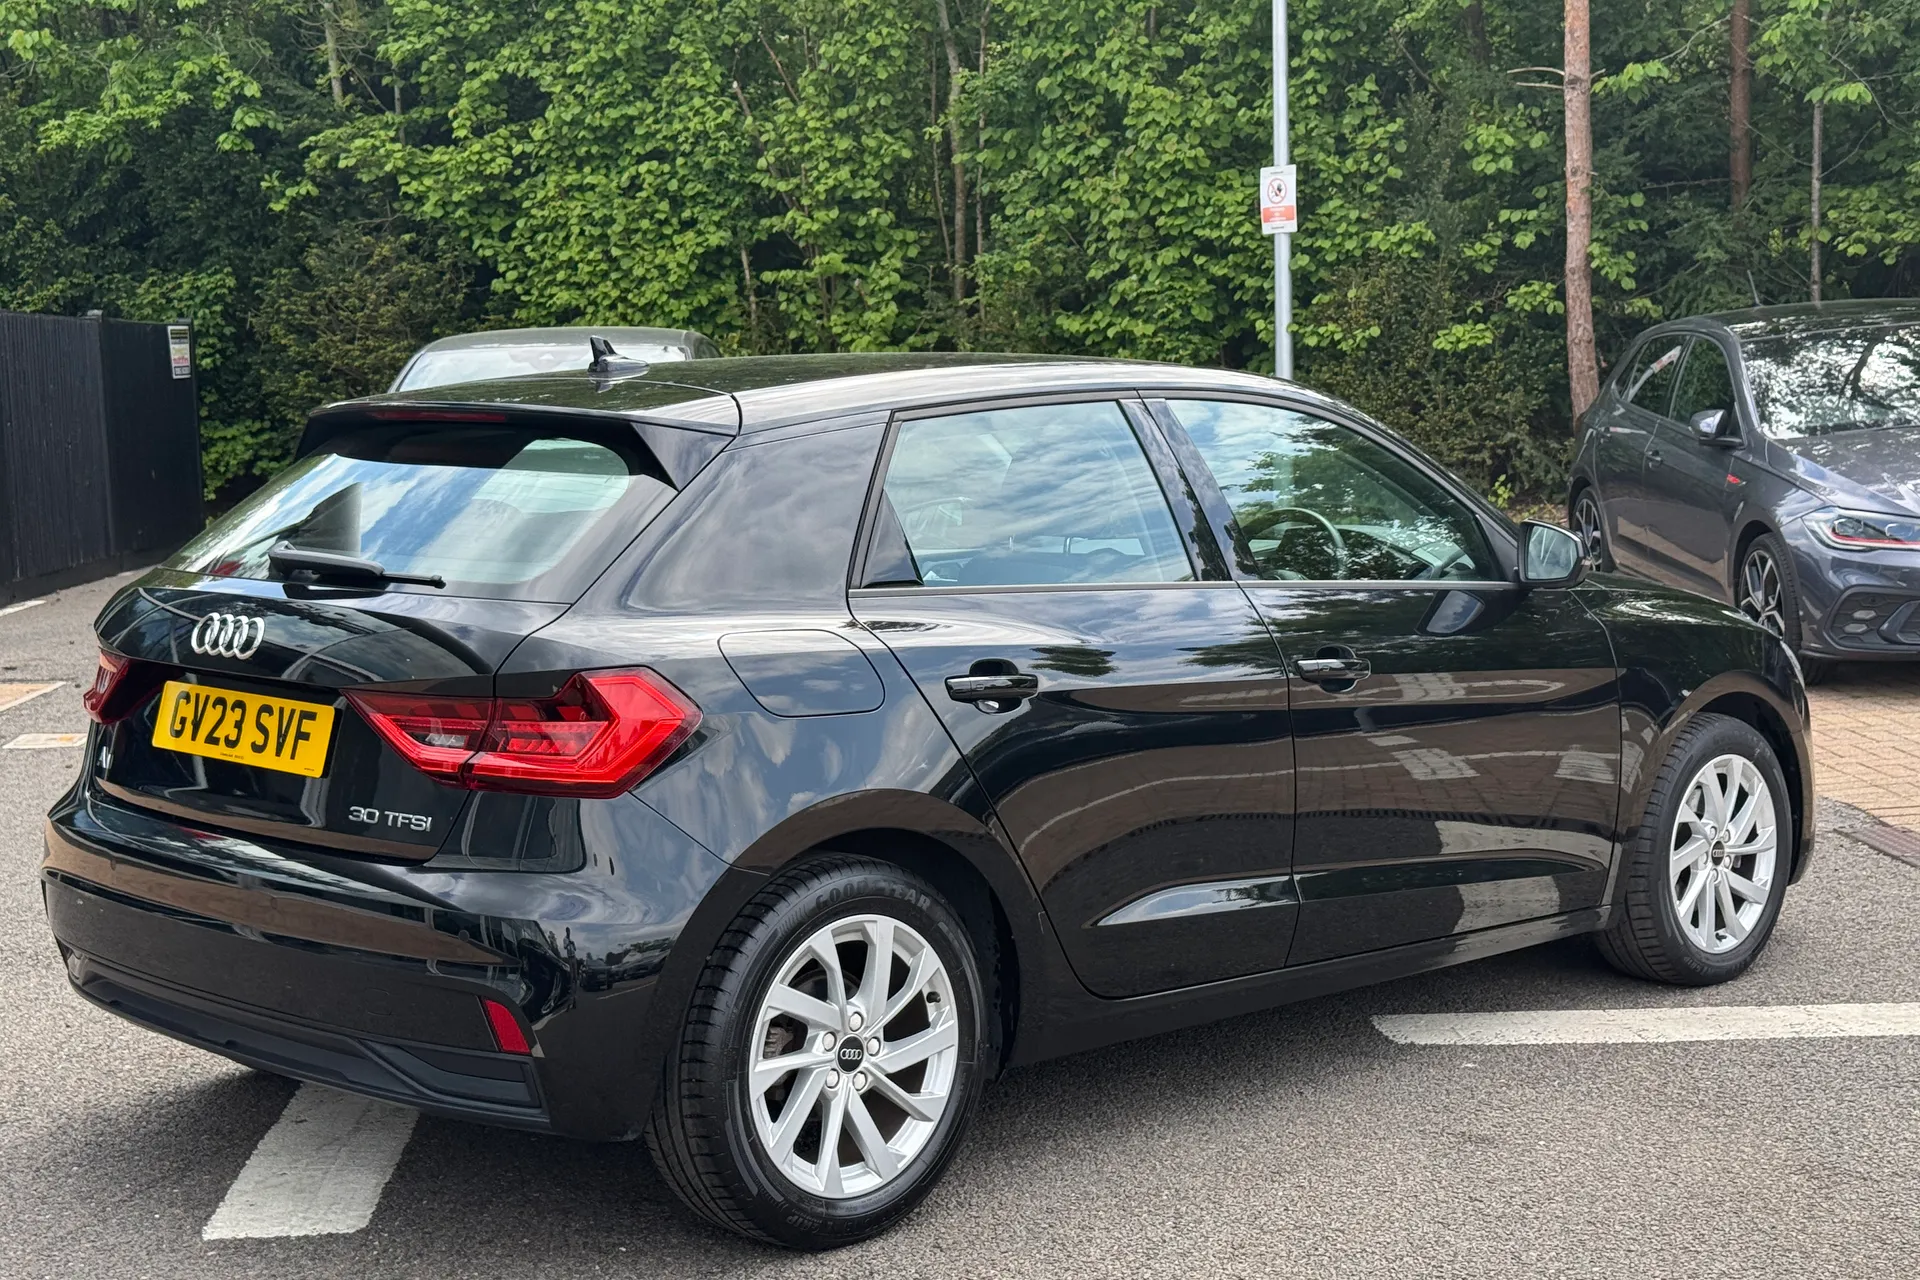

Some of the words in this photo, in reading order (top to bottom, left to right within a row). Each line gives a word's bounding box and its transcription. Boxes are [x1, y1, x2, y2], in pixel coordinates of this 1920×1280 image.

[170, 690, 247, 749] GV23
[250, 703, 318, 761] SVF
[348, 806, 379, 824] 30
[384, 811, 432, 832] TFSI
